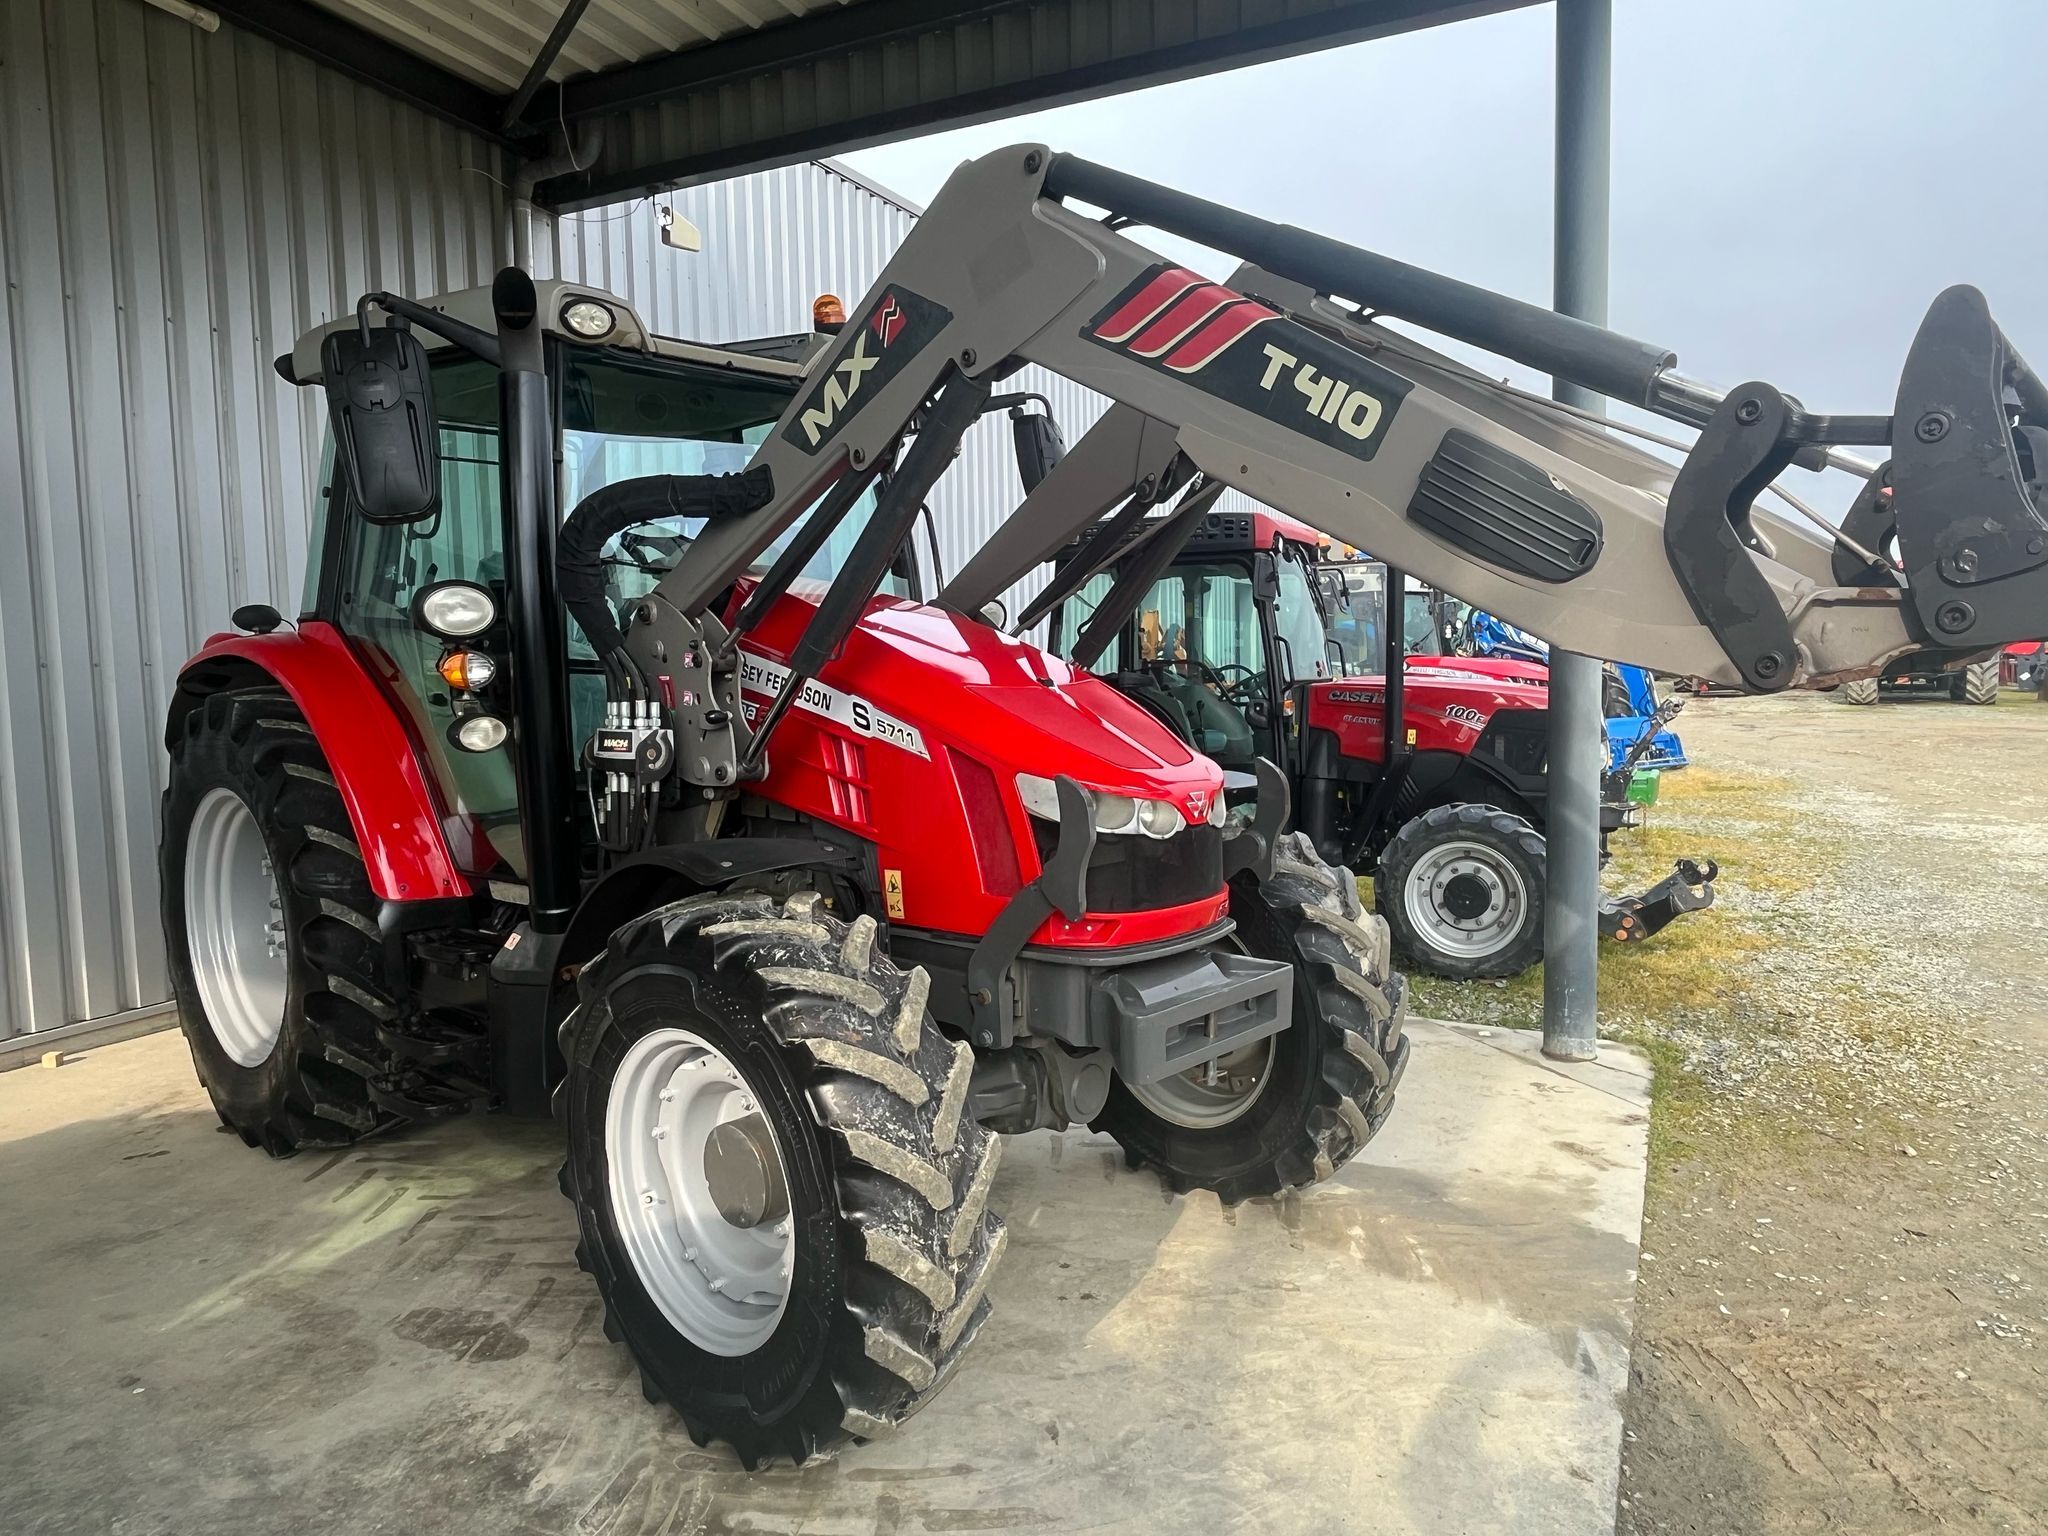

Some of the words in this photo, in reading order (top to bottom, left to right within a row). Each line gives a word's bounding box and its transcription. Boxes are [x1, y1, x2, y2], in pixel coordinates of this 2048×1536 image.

[800, 328, 880, 447] MX
[1260, 343, 1382, 440] T410
[741, 663, 763, 684] SEY
[852, 701, 871, 731] S
[876, 718, 915, 748] 5711
